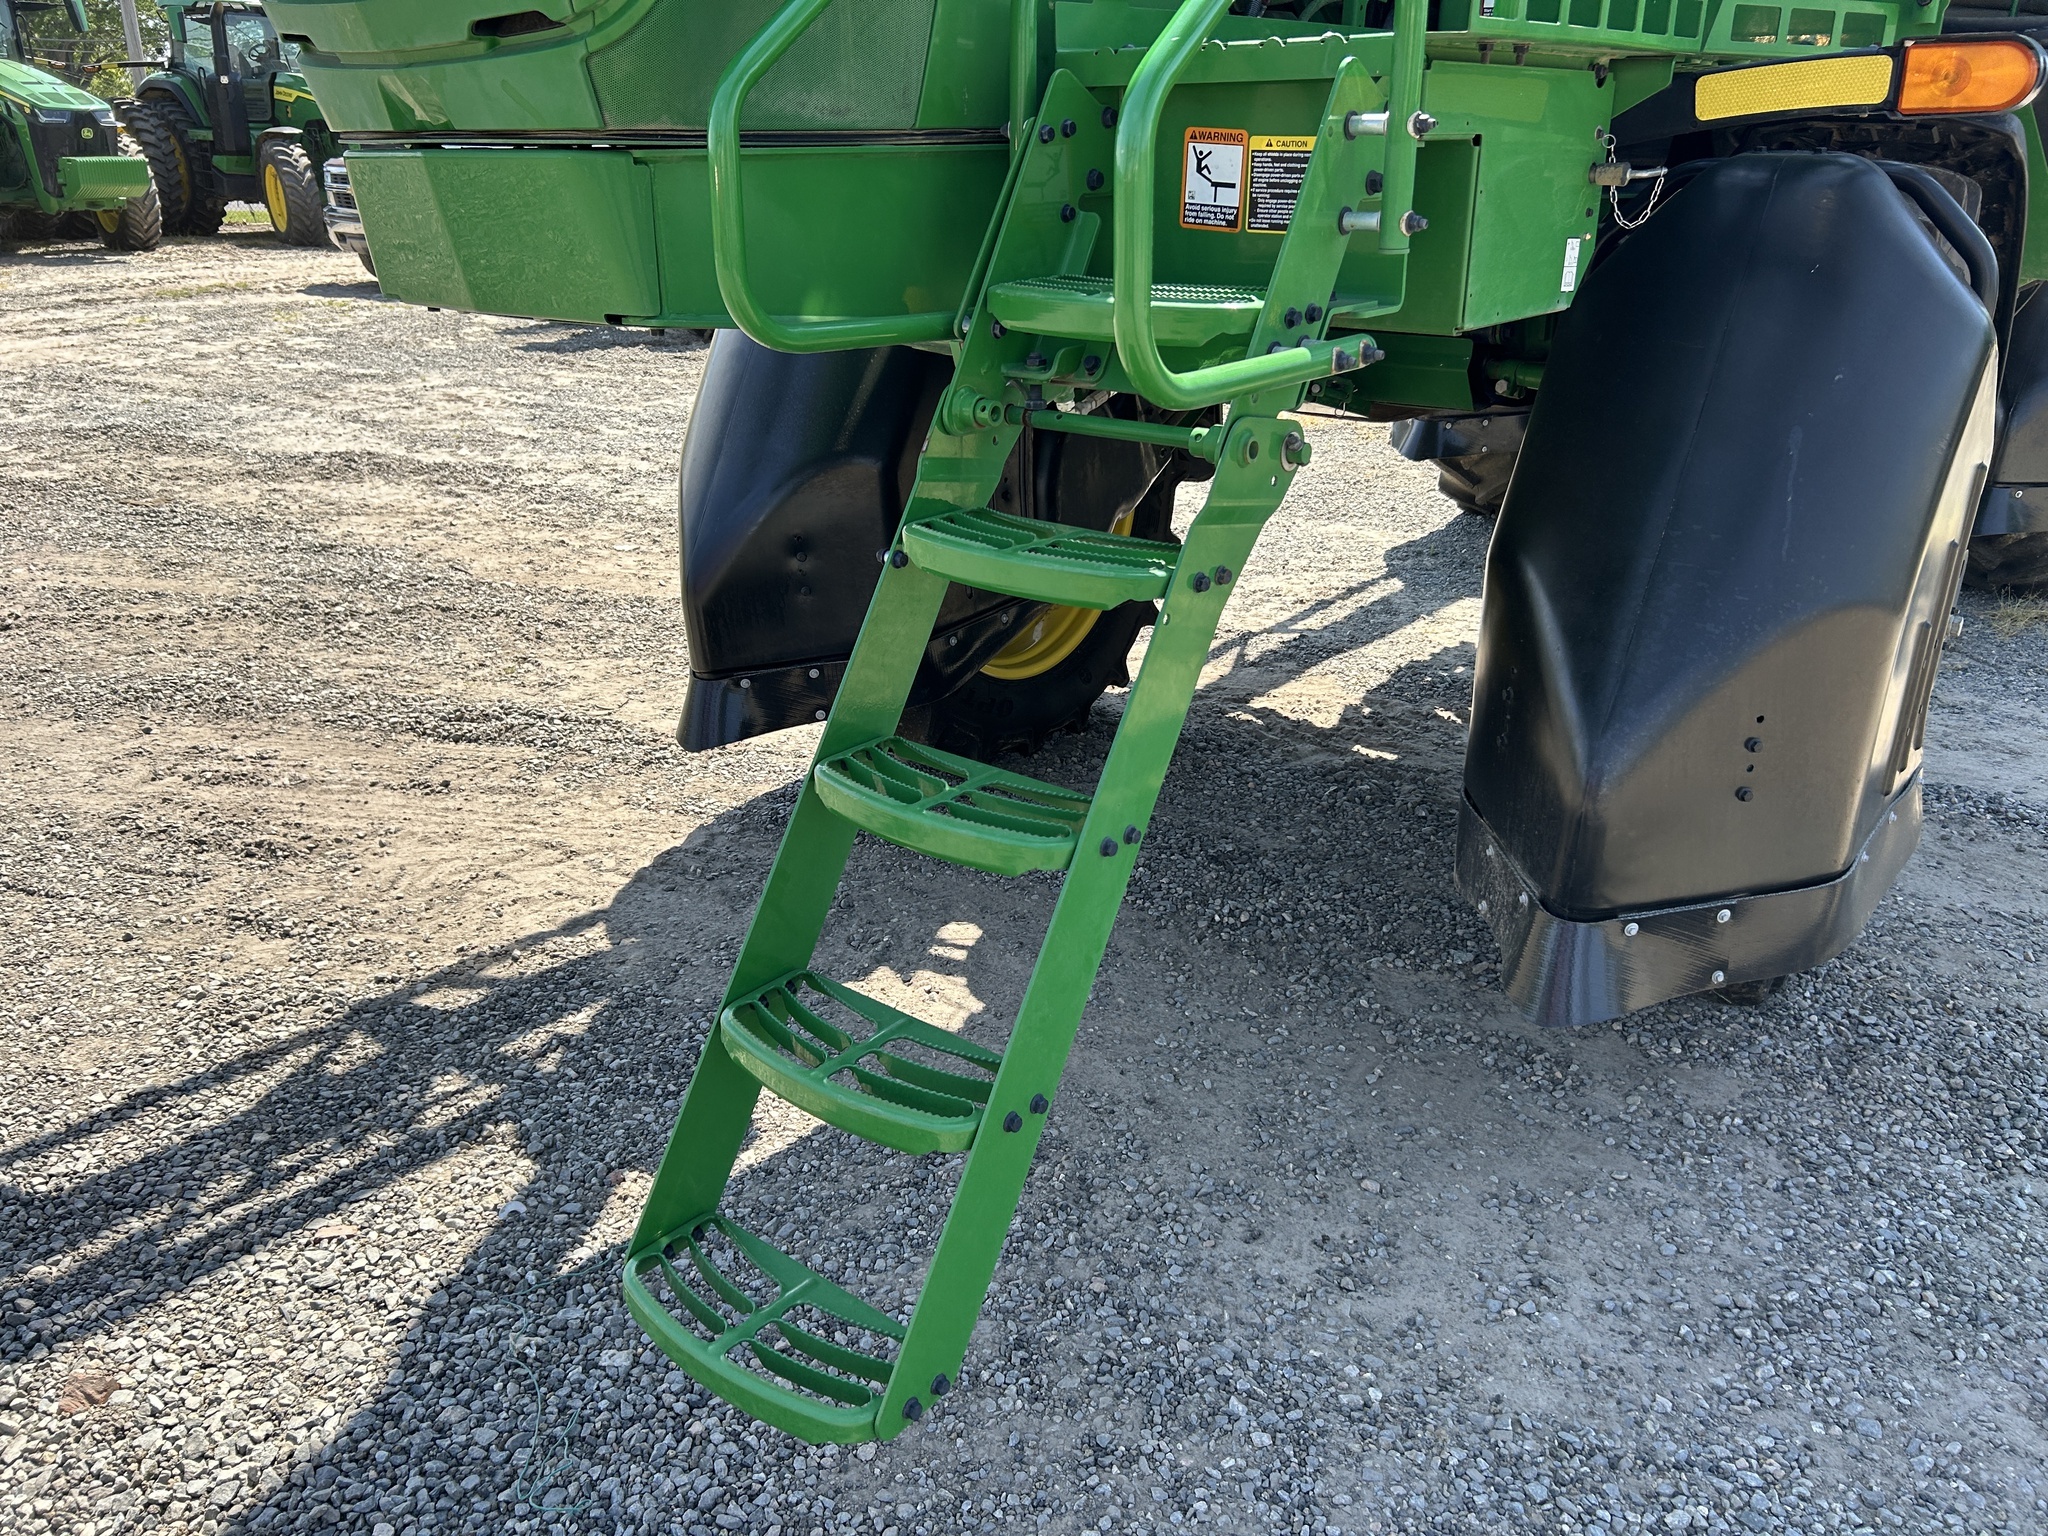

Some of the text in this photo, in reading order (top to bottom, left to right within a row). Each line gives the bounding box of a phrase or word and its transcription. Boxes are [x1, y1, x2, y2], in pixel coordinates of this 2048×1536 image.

[1198, 130, 1244, 142] WARNING
[1198, 211, 1215, 219] falling.
[1222, 207, 1237, 215] injury
